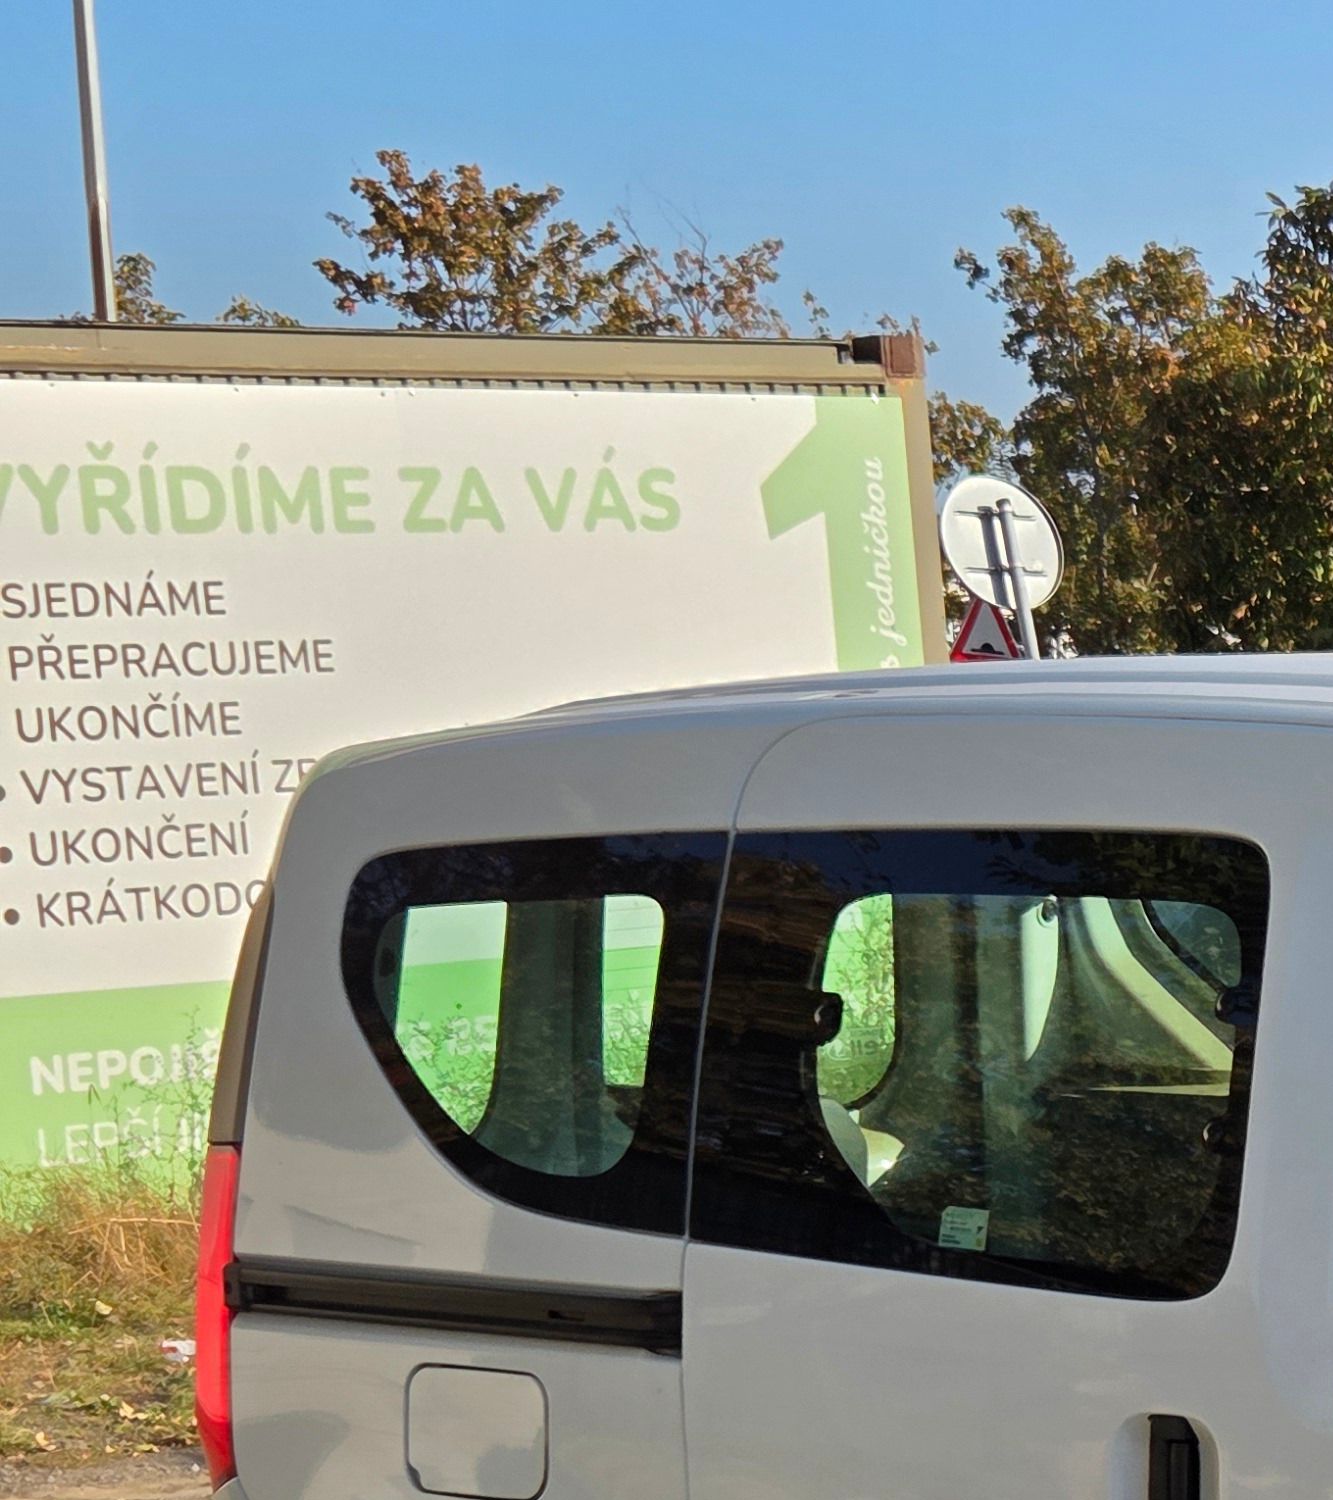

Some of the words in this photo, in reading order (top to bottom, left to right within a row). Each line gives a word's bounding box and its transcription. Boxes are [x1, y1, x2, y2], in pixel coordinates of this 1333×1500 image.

[397, 465, 505, 534] ZA
[524, 445, 681, 533] VÁS
[860, 456, 908, 647] jedničkou
[0, 569, 227, 619] SJEDNÁME
[7, 633, 336, 682] PŘEPRACUJEME
[15, 691, 242, 743] UKONČÍME
[20, 748, 260, 805] VYSTAVENÍ
[29, 809, 249, 867] UKONČENÍ
